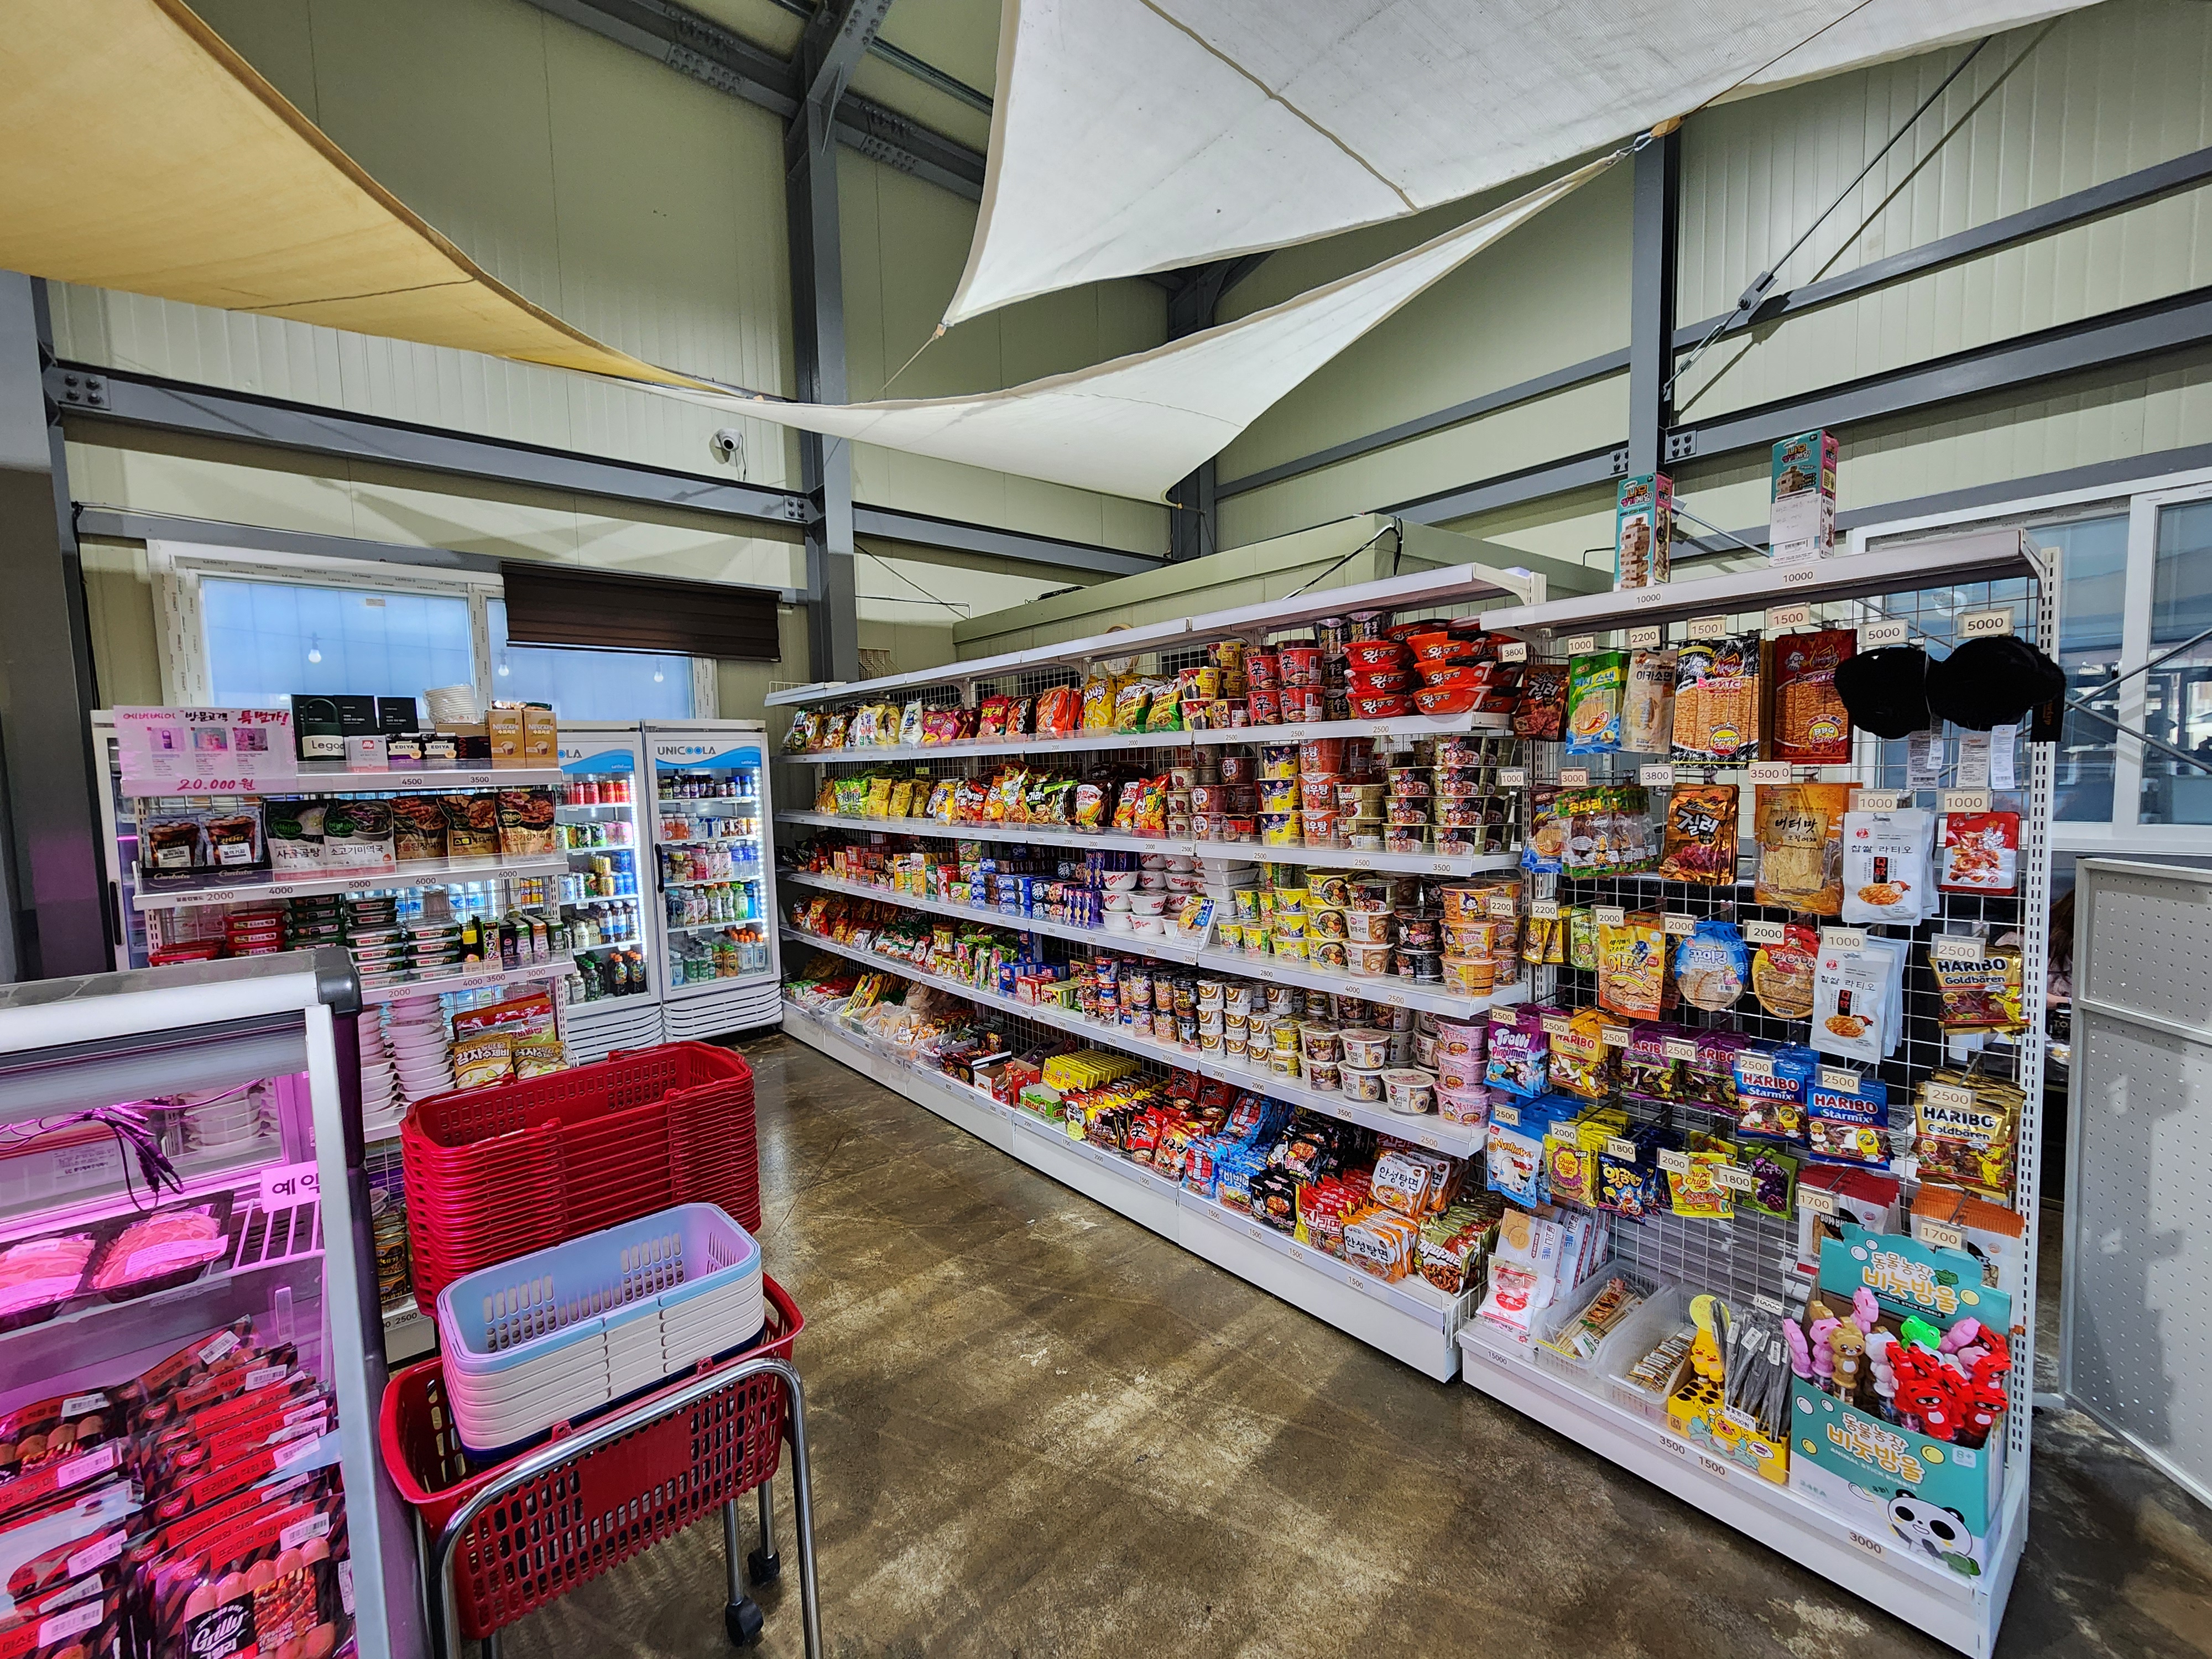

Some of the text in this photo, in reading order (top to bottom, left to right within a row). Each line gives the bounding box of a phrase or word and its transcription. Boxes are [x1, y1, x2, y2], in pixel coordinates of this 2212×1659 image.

[1783, 570, 1814, 583] 10000
[1636, 592, 1661, 604] 10000
[1773, 612, 1804, 625] 1500
[1967, 617, 2004, 631] 5000
[1631, 631, 1657, 643] 2200
[1868, 627, 1901, 640] 5000
[1569, 640, 1592, 651] 1000
[1504, 648, 1524, 658] 3800
[1251, 660, 1266, 684] 辛
[1282, 654, 1295, 678] 辛
[1696, 677, 1743, 690] Bento
[1255, 694, 1271, 718] 辛
[1291, 729, 1306, 738] 2500
[1813, 727, 1835, 736] BBQ
[557, 749, 583, 759] OLA
[657, 746, 717, 756] UNICOOLA
[1502, 774, 1522, 783] 1000
[1562, 774, 1584, 783] 3000
[1645, 771, 1669, 780] 3800
[238, 778, 255, 791] 원
[1302, 784, 1328, 796] 새우탕
[1860, 798, 1893, 808] 1000
[1945, 797, 1983, 808] 1000
[1676, 808, 1720, 838] 질러
[1775, 817, 1818, 834] 버터 맛
[276, 847, 321, 859] 사골곰탕
[331, 844, 384, 856] 소고기미역국
[1850, 845, 1913, 854] 찹쌀 라티오
[1433, 863, 1451, 872] 3500
[268, 886, 294, 895] 4000
[348, 880, 371, 889] 5000
[207, 891, 234, 901] 2000
[1491, 902, 1511, 911] 2200
[1535, 906, 1556, 915] 2200
[1599, 914, 1620, 923] 2000
[1668, 921, 1694, 932] 2000
[1754, 927, 1782, 939] 2000
[1828, 936, 1860, 947] 1000
[1938, 945, 1975, 958] 2500
[1937, 958, 2007, 973] HARIBO
[486, 974, 506, 983] 3500
[526, 968, 546, 978] 3000
[1260, 969, 1274, 978] 2800
[1945, 974, 2006, 984] Goldbären
[463, 978, 483, 987] 4000
[1820, 974, 1840, 985] 찹쌀
[389, 988, 411, 998] 2000
[1345, 985, 1360, 994] 4000
[1388, 994, 1405, 1004] 2500
[1493, 1011, 1512, 1022] 2500
[1543, 1021, 1565, 1032] 2500
[1494, 1028, 1532, 1048] Trolli
[1602, 1032, 1626, 1044] 2500
[456, 1047, 510, 1067] 감자수제비
[1667, 1045, 1693, 1057] 2500
[1741, 1060, 1769, 1072] 2500
[1213, 1070, 1225, 1079] 2000
[1251, 1082, 1265, 1091] 2000
[1743, 1072, 1799, 1092] HARIBO
[1823, 1074, 1855, 1088] 2500
[1747, 1086, 1793, 1101] Starmix
[1932, 1089, 1969, 1105] 2500
[1814, 1093, 1879, 1114] HARIBO
[1337, 1108, 1352, 1119] 3500
[1495, 1109, 1516, 1121] 2500
[1822, 1108, 1870, 1124] Starmix
[1923, 1106, 1996, 1129] HARIBO
[1553, 1127, 1575, 1140] 2000
[1927, 1123, 1991, 1141] Goldbären
[1421, 1136, 1438, 1147] 2500
[1610, 1142, 1634, 1155] 1800
[1558, 1156, 1577, 1167] Chupa
[1661, 1155, 1686, 1169] 2000
[1557, 1162, 1575, 1175] Chups
[1378, 1166, 1420, 1191] 안성탕면
[1723, 1173, 1750, 1187] 1800
[1799, 1194, 1830, 1210] 1700
[1304, 1207, 1342, 1235] 진라면
[1249, 1228, 1262, 1239] 1500
[1922, 1227, 1958, 1245] 1700
[1288, 1247, 1303, 1260] 1500
[1344, 1235, 1390, 1262] 안성탕면
[1871, 1251, 1934, 1281] 동물농장
[1348, 1276, 1364, 1290] 1500
[1863, 1266, 1959, 1316] 비눗방울
[1755, 1297, 1781, 1311] 10000
[1877, 1292, 1943, 1318] ANIMAL STICK BUBBLE
[395, 1312, 418, 1325] 2500
[1488, 1351, 1507, 1365] 15000
[1842, 1412, 1910, 1453] 동물농장
[1659, 1436, 1686, 1455] 3500
[1827, 1423, 1925, 1484] 비눗방울
[1698, 1455, 1726, 1476] 1500
[1849, 1531, 1882, 1554] 3000
[192, 1613, 245, 1653] Grilly
